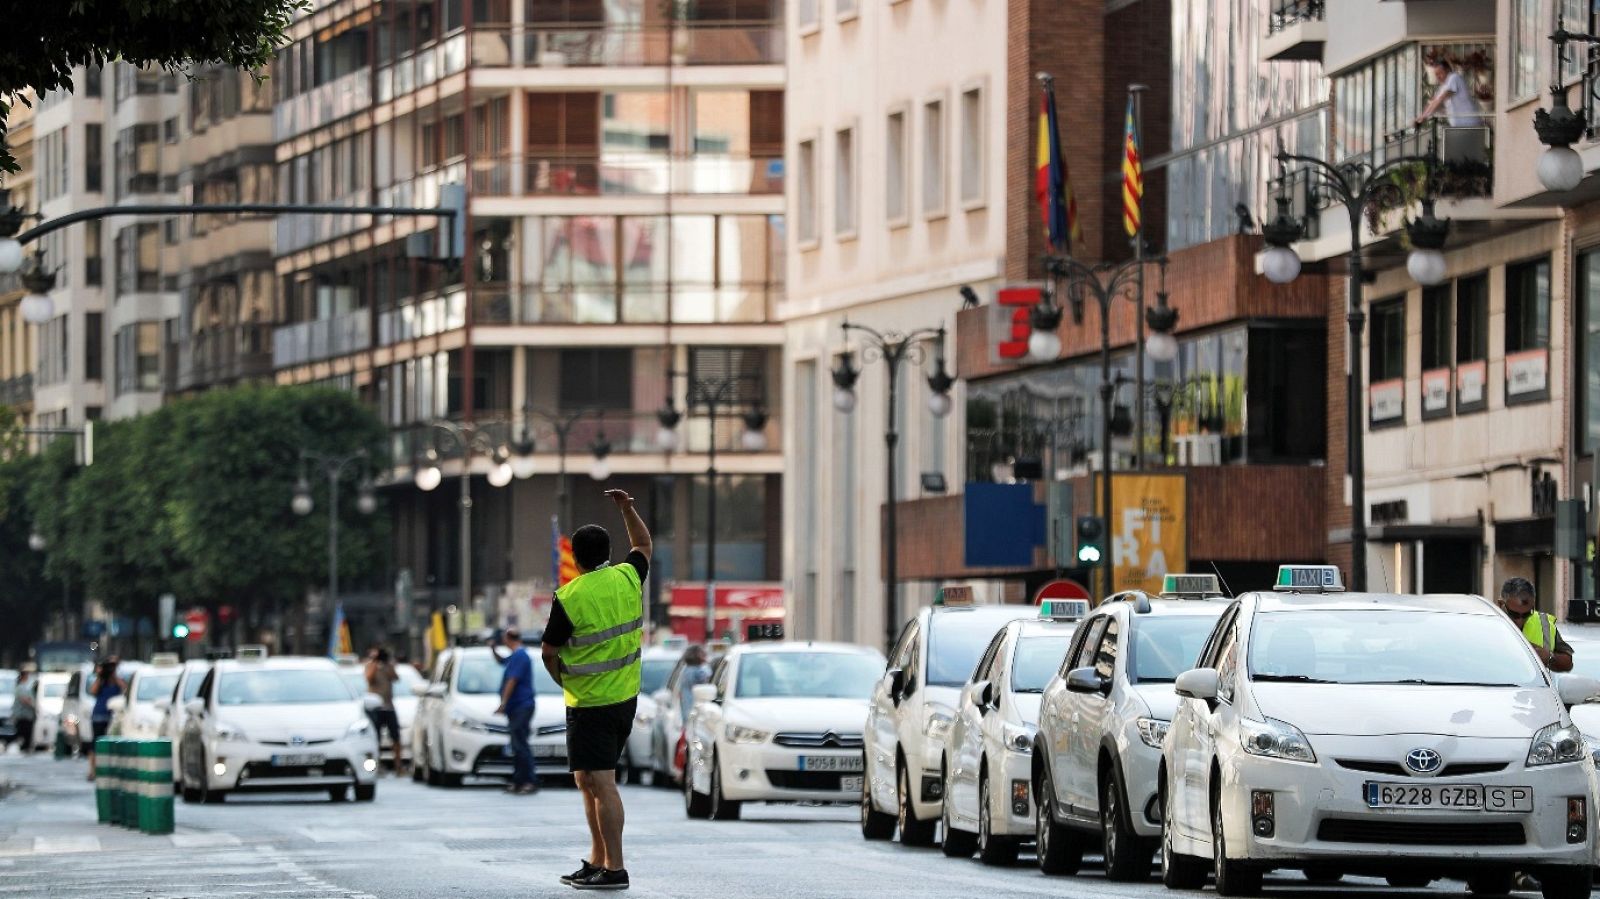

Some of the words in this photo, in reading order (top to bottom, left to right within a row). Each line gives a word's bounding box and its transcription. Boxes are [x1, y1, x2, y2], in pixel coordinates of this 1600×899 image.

[1177, 577, 1202, 592] TAXI
[1293, 569, 1321, 586] TAXI
[1052, 602, 1075, 616] TAXI
[807, 757, 837, 769] 9058
[1382, 787, 1432, 806] 6228
[1440, 788, 1478, 807] GZB
[1491, 790, 1526, 808] SP
